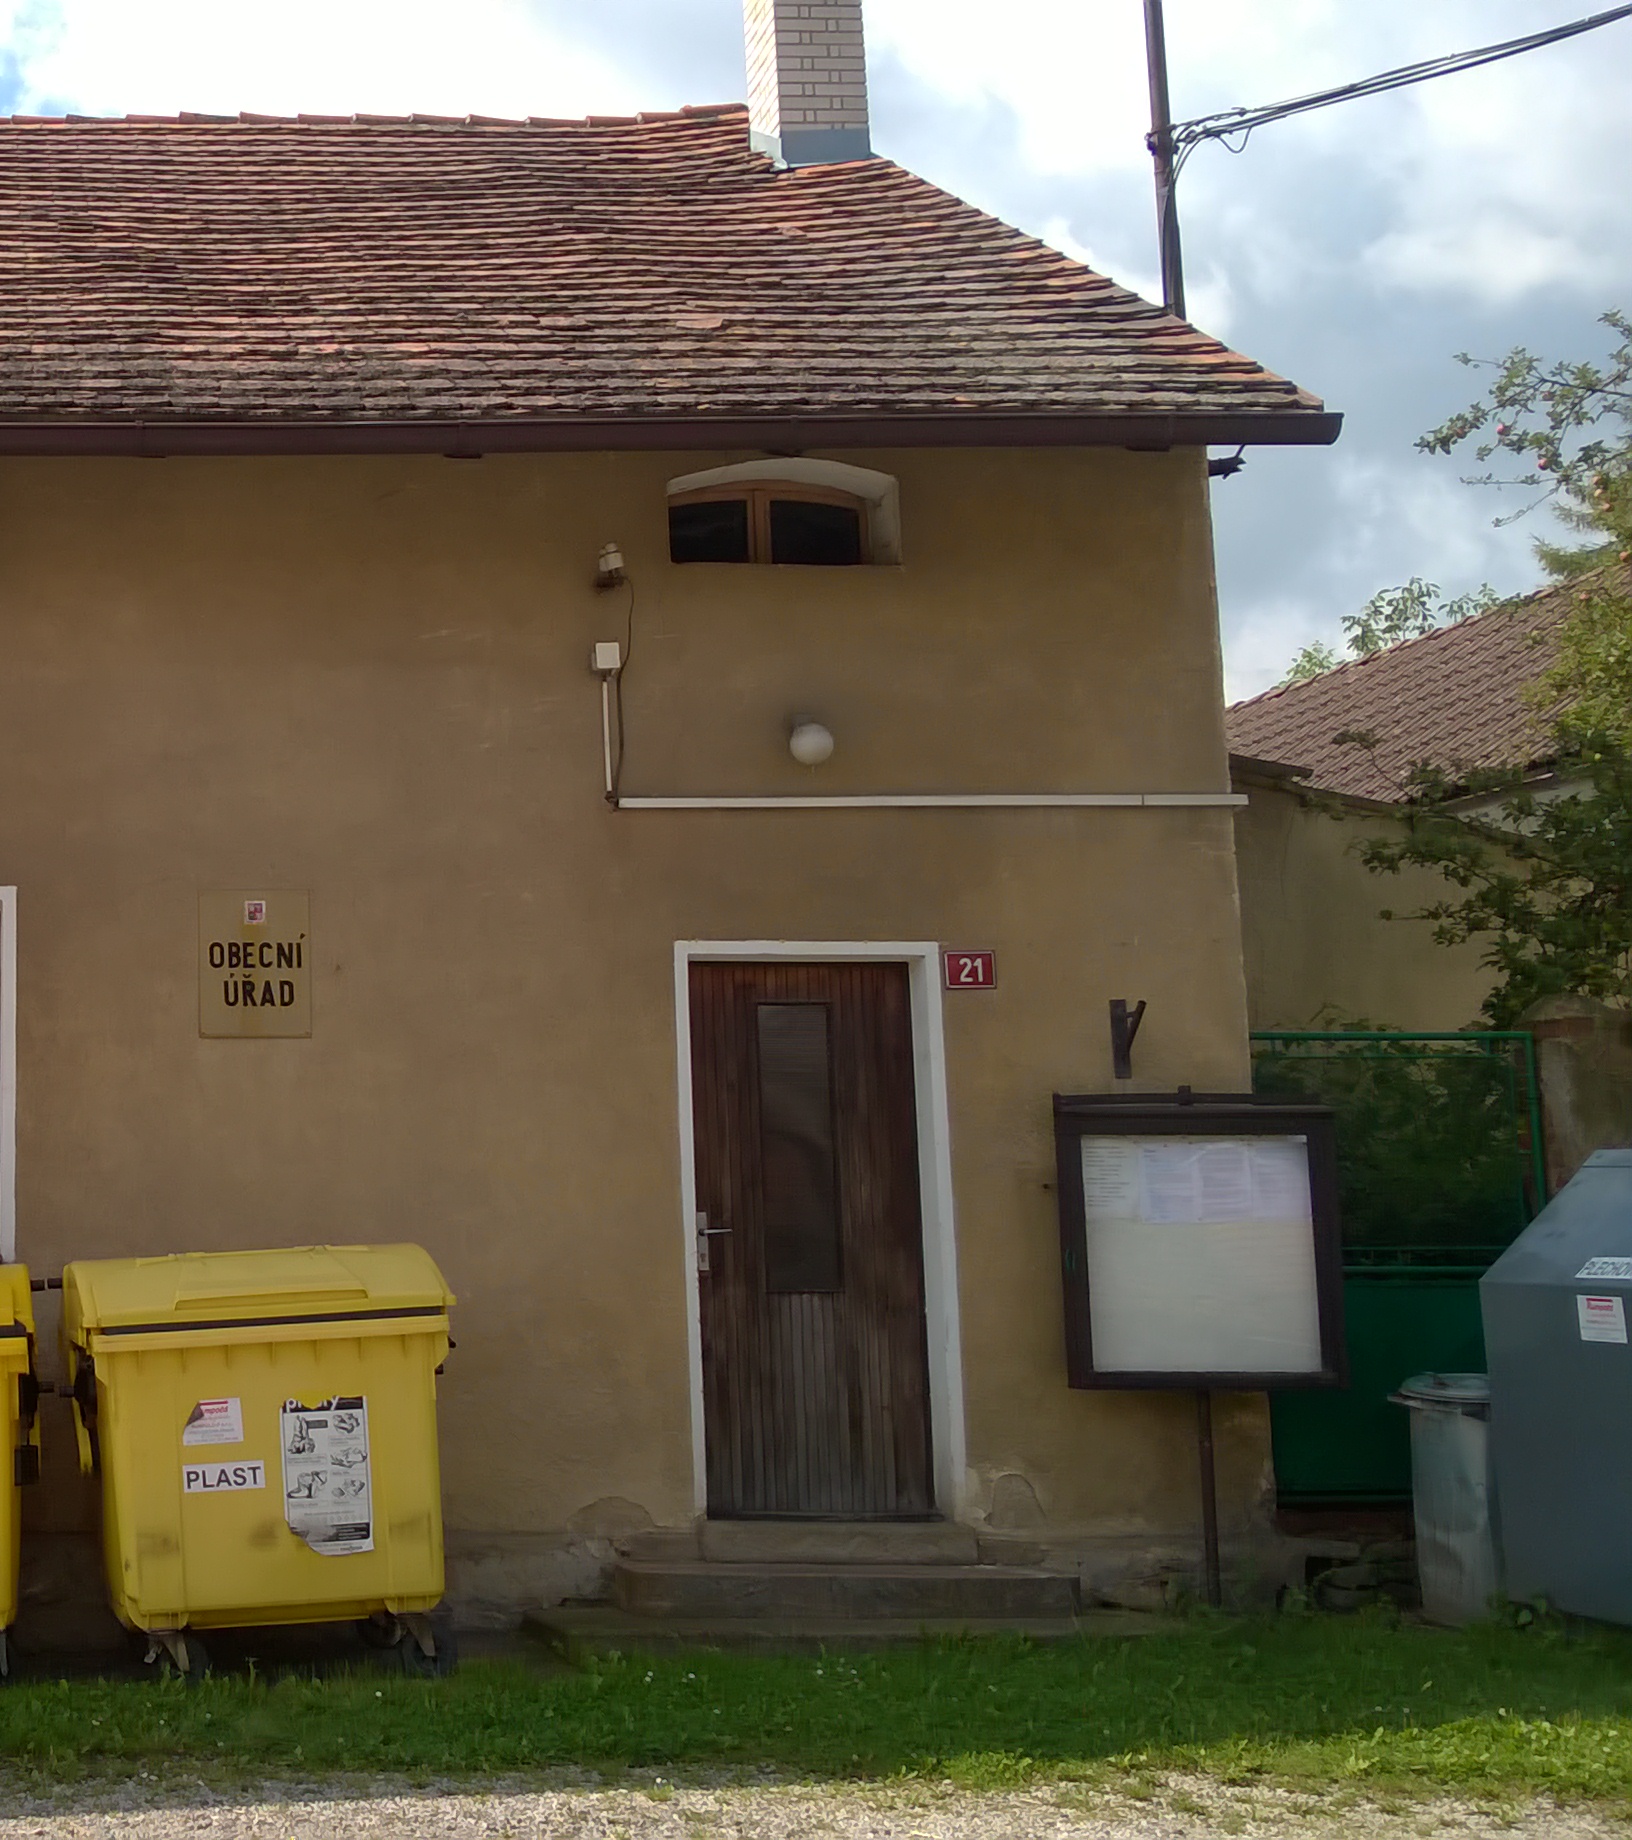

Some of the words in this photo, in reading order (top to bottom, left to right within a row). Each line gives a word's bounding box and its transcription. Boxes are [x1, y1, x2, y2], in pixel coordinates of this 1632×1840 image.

[209, 933, 306, 969] OBECNÍ
[958, 957, 984, 983] 21
[223, 973, 295, 1007] ÚŘAD
[186, 1466, 261, 1489] PLAST
